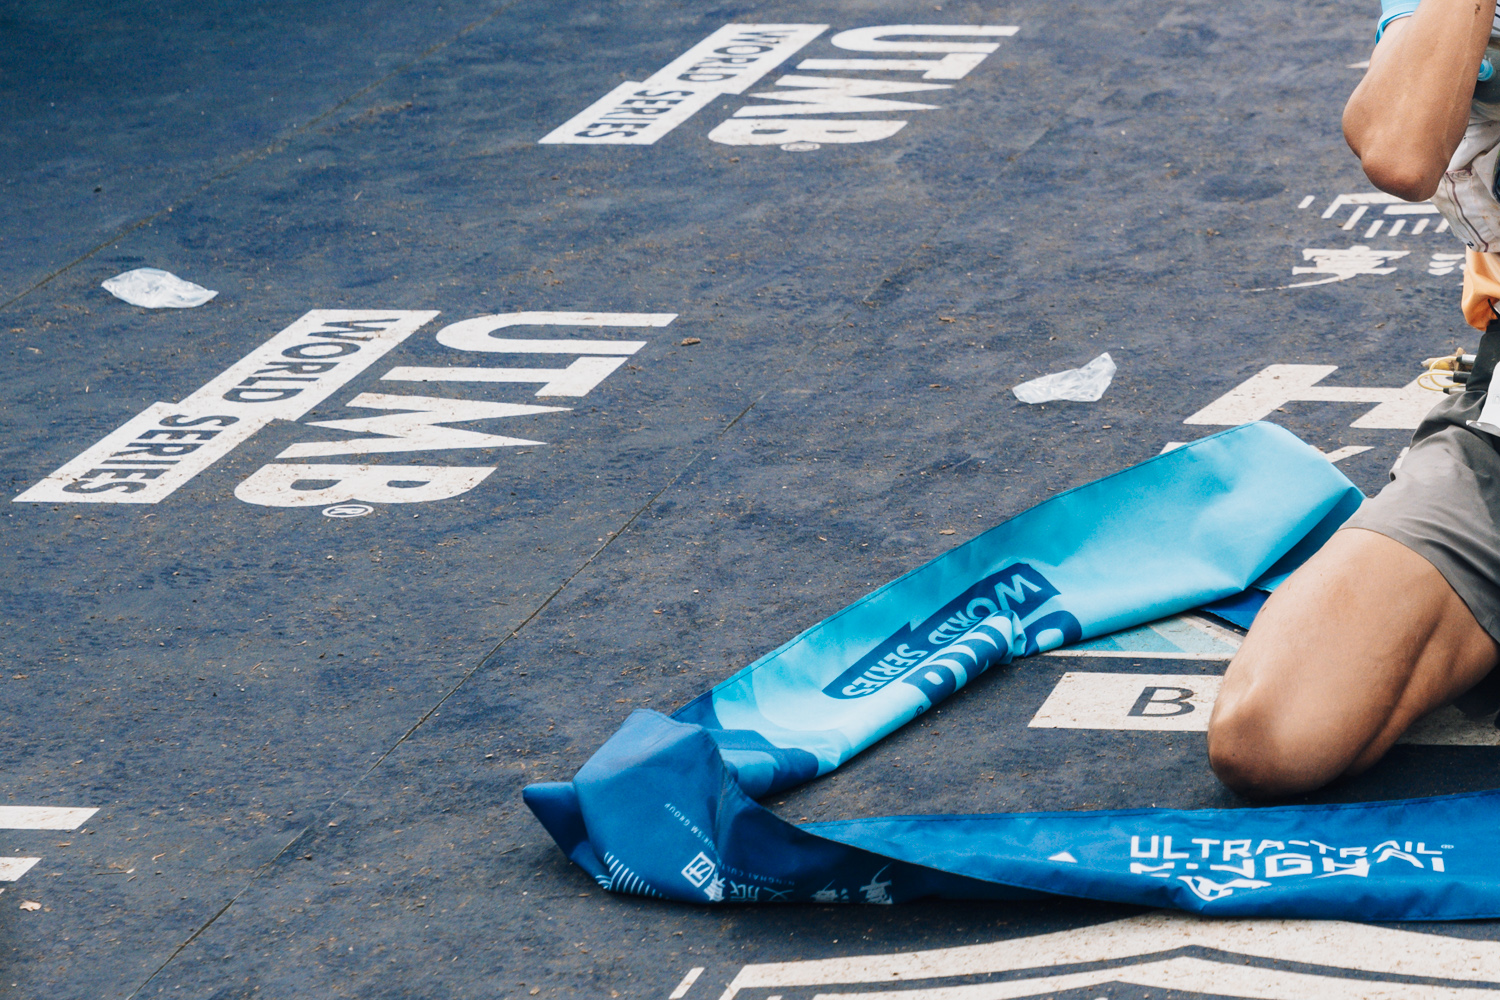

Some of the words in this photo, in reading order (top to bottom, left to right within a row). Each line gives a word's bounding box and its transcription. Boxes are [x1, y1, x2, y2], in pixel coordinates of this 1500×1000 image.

[573, 89, 696, 139] SERIES
[221, 316, 397, 404] WORLD
[62, 413, 210, 496] SERIES
[841, 643, 929, 697] SERIES
[1126, 685, 1195, 718] B
